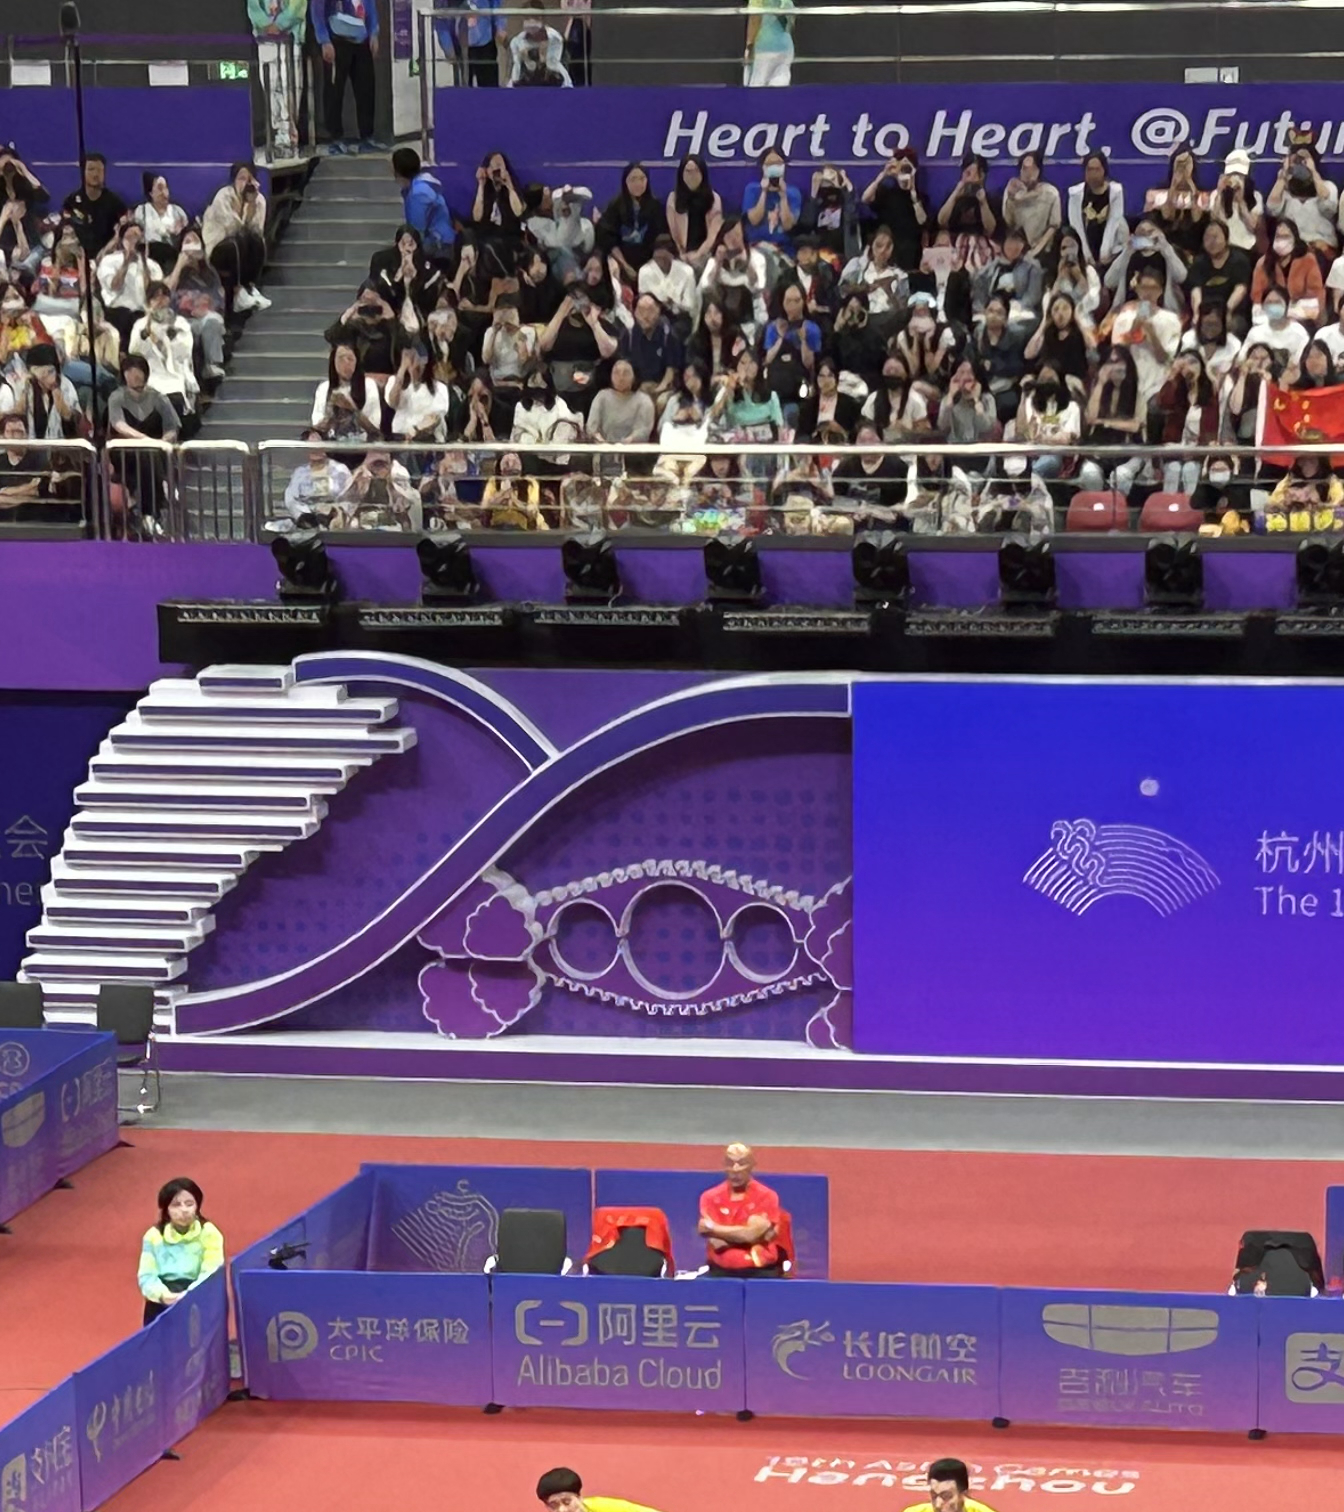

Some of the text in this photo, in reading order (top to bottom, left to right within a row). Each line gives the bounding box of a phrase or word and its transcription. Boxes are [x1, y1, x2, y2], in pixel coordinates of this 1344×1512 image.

[663, 110, 831, 158] Heart
[852, 112, 910, 156] to
[1255, 887, 1319, 917] The
[598, 1303, 721, 1350] 阿里云
[329, 1344, 385, 1363] CPIC
[517, 1354, 722, 1390] Alibaba Cloud
